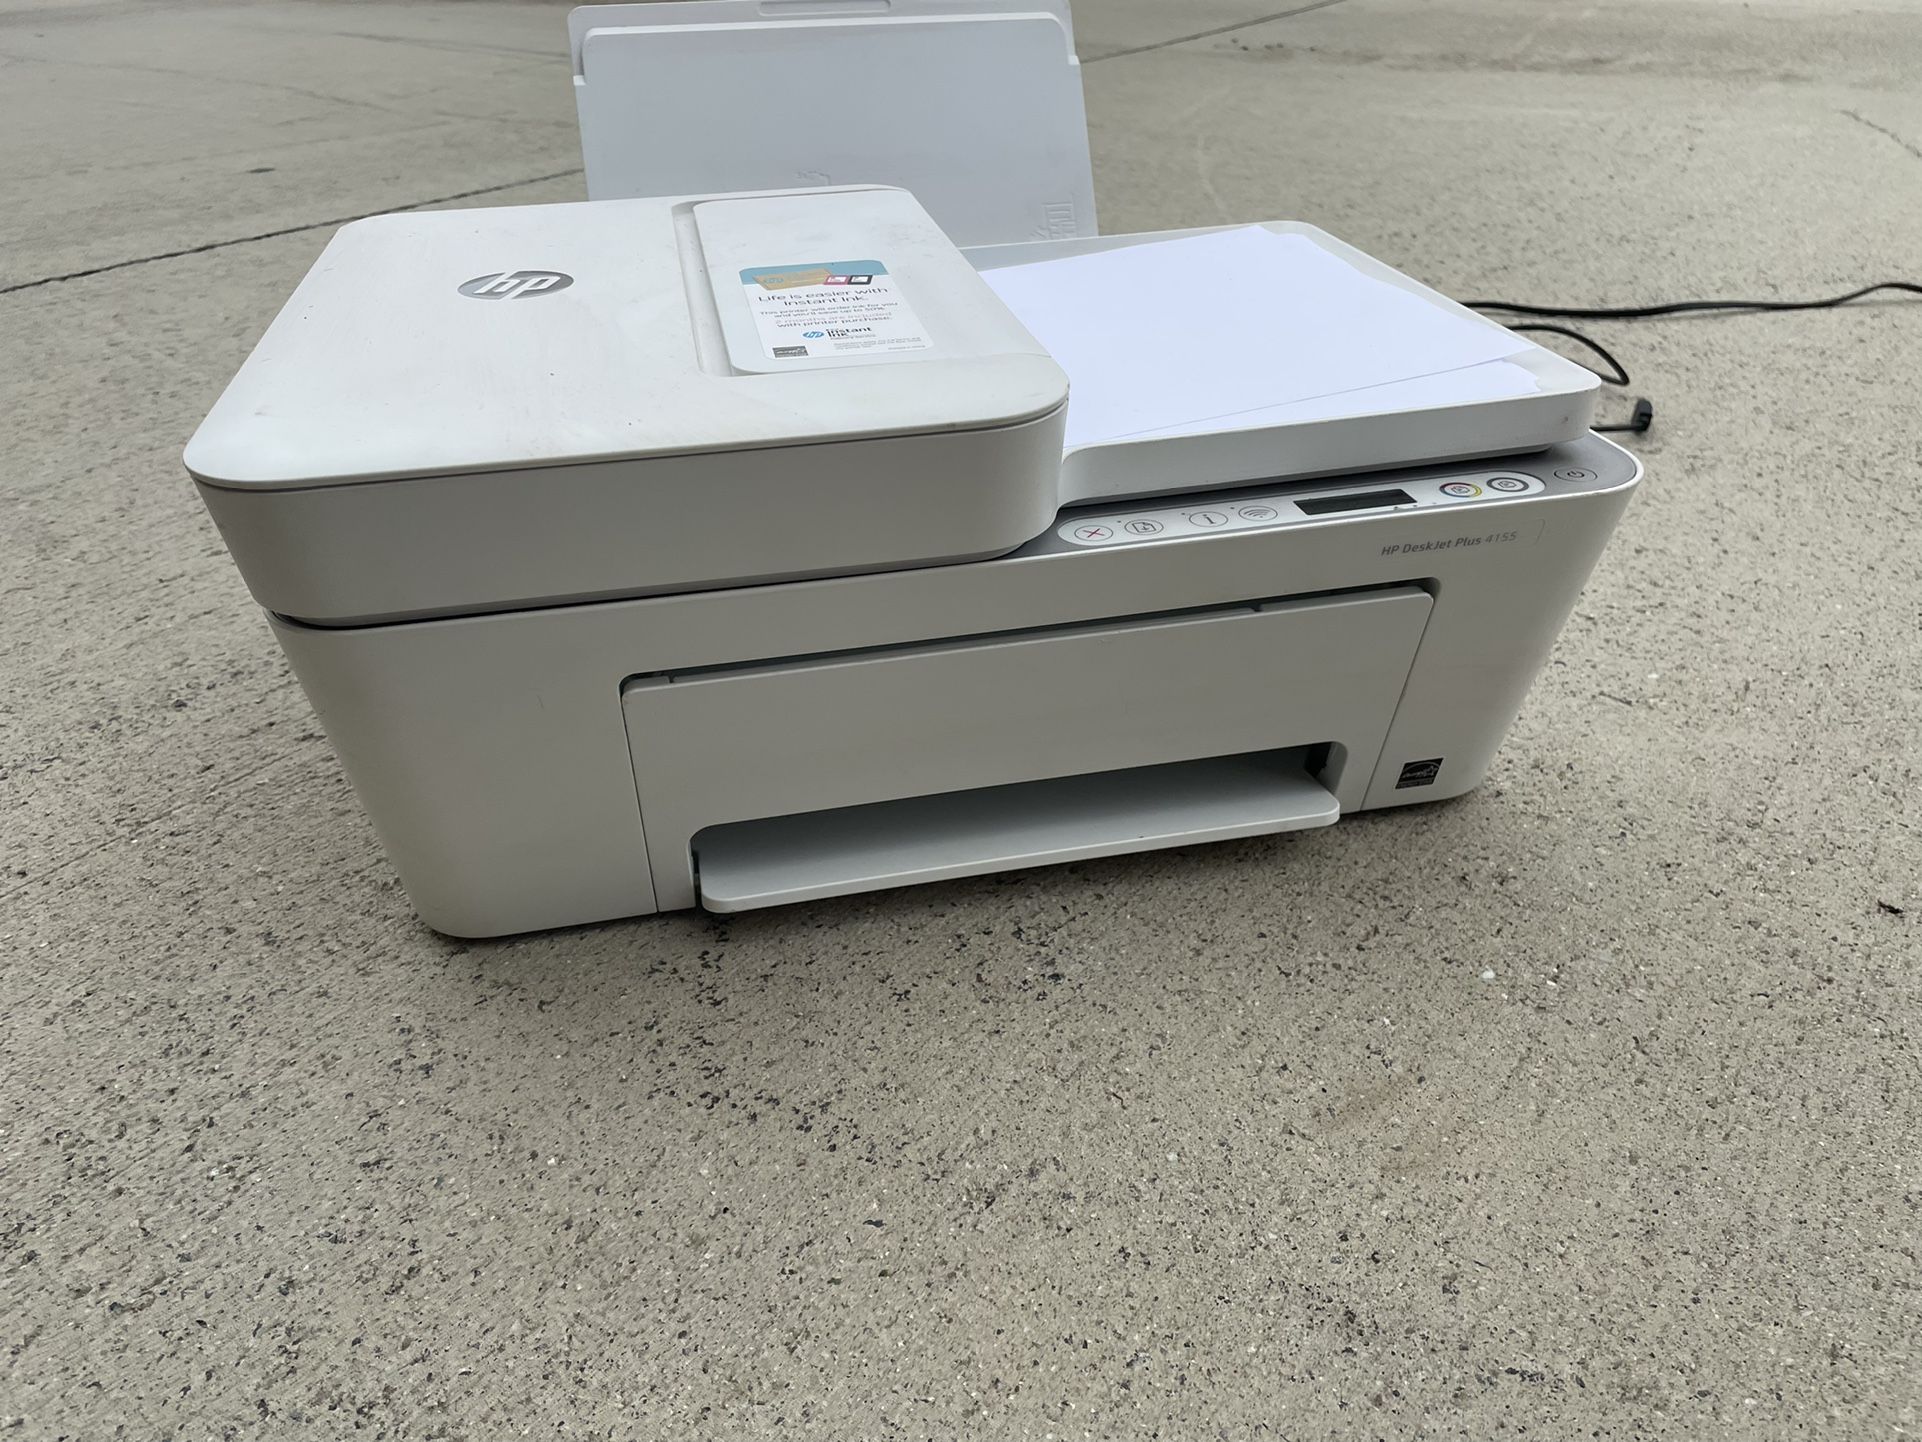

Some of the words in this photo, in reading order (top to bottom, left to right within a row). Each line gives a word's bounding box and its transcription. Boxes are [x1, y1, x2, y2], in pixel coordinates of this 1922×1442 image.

[472, 271, 562, 300] hp
[784, 298, 837, 306] Instant
[1381, 545, 1400, 556] HP
[1402, 539, 1452, 554] DeskJet
[1454, 537, 1482, 548] Plus
[1485, 531, 1518, 543] 4155
